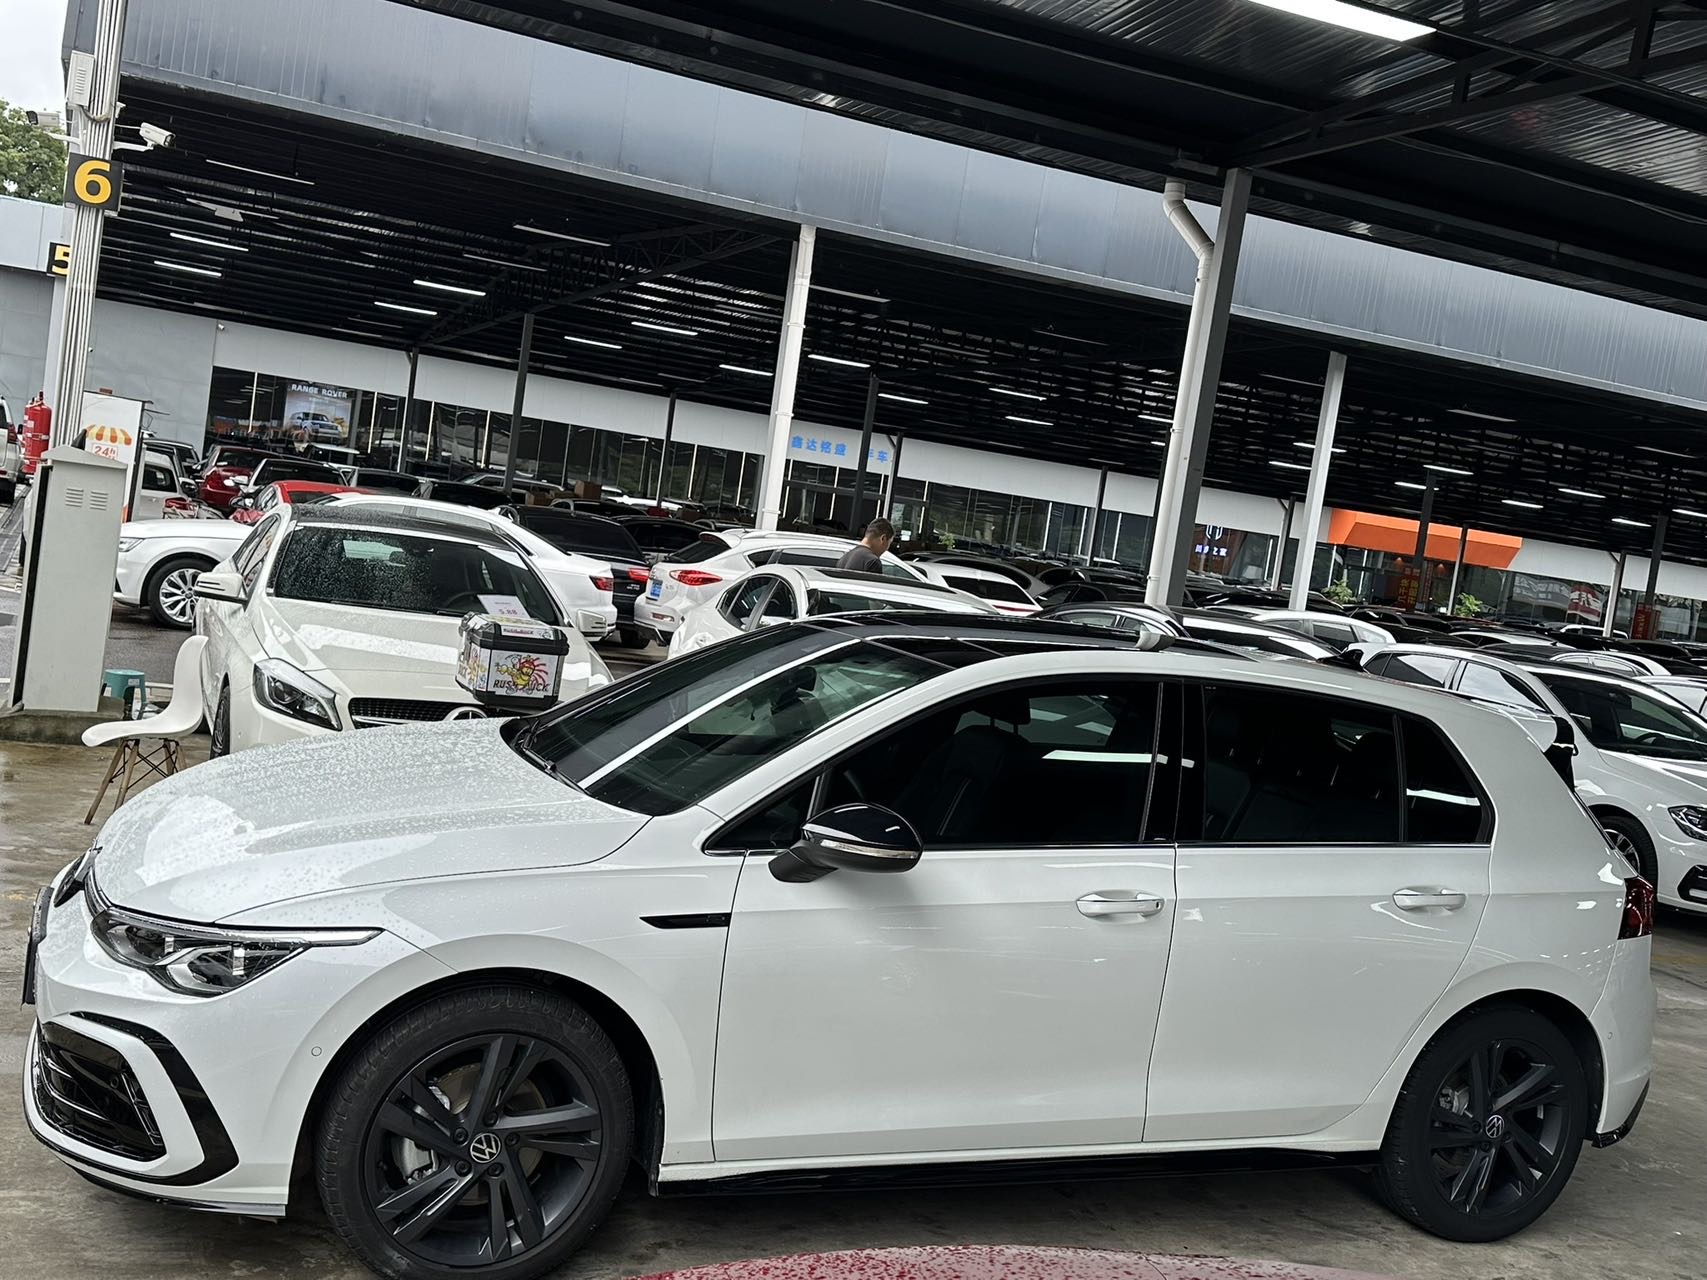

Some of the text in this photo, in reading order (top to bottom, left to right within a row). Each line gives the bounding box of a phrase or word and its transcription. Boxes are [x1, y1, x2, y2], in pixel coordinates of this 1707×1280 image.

[73, 159, 112, 205] 6
[51, 244, 71, 277] 5
[291, 384, 348, 399] RANGE ROVER
